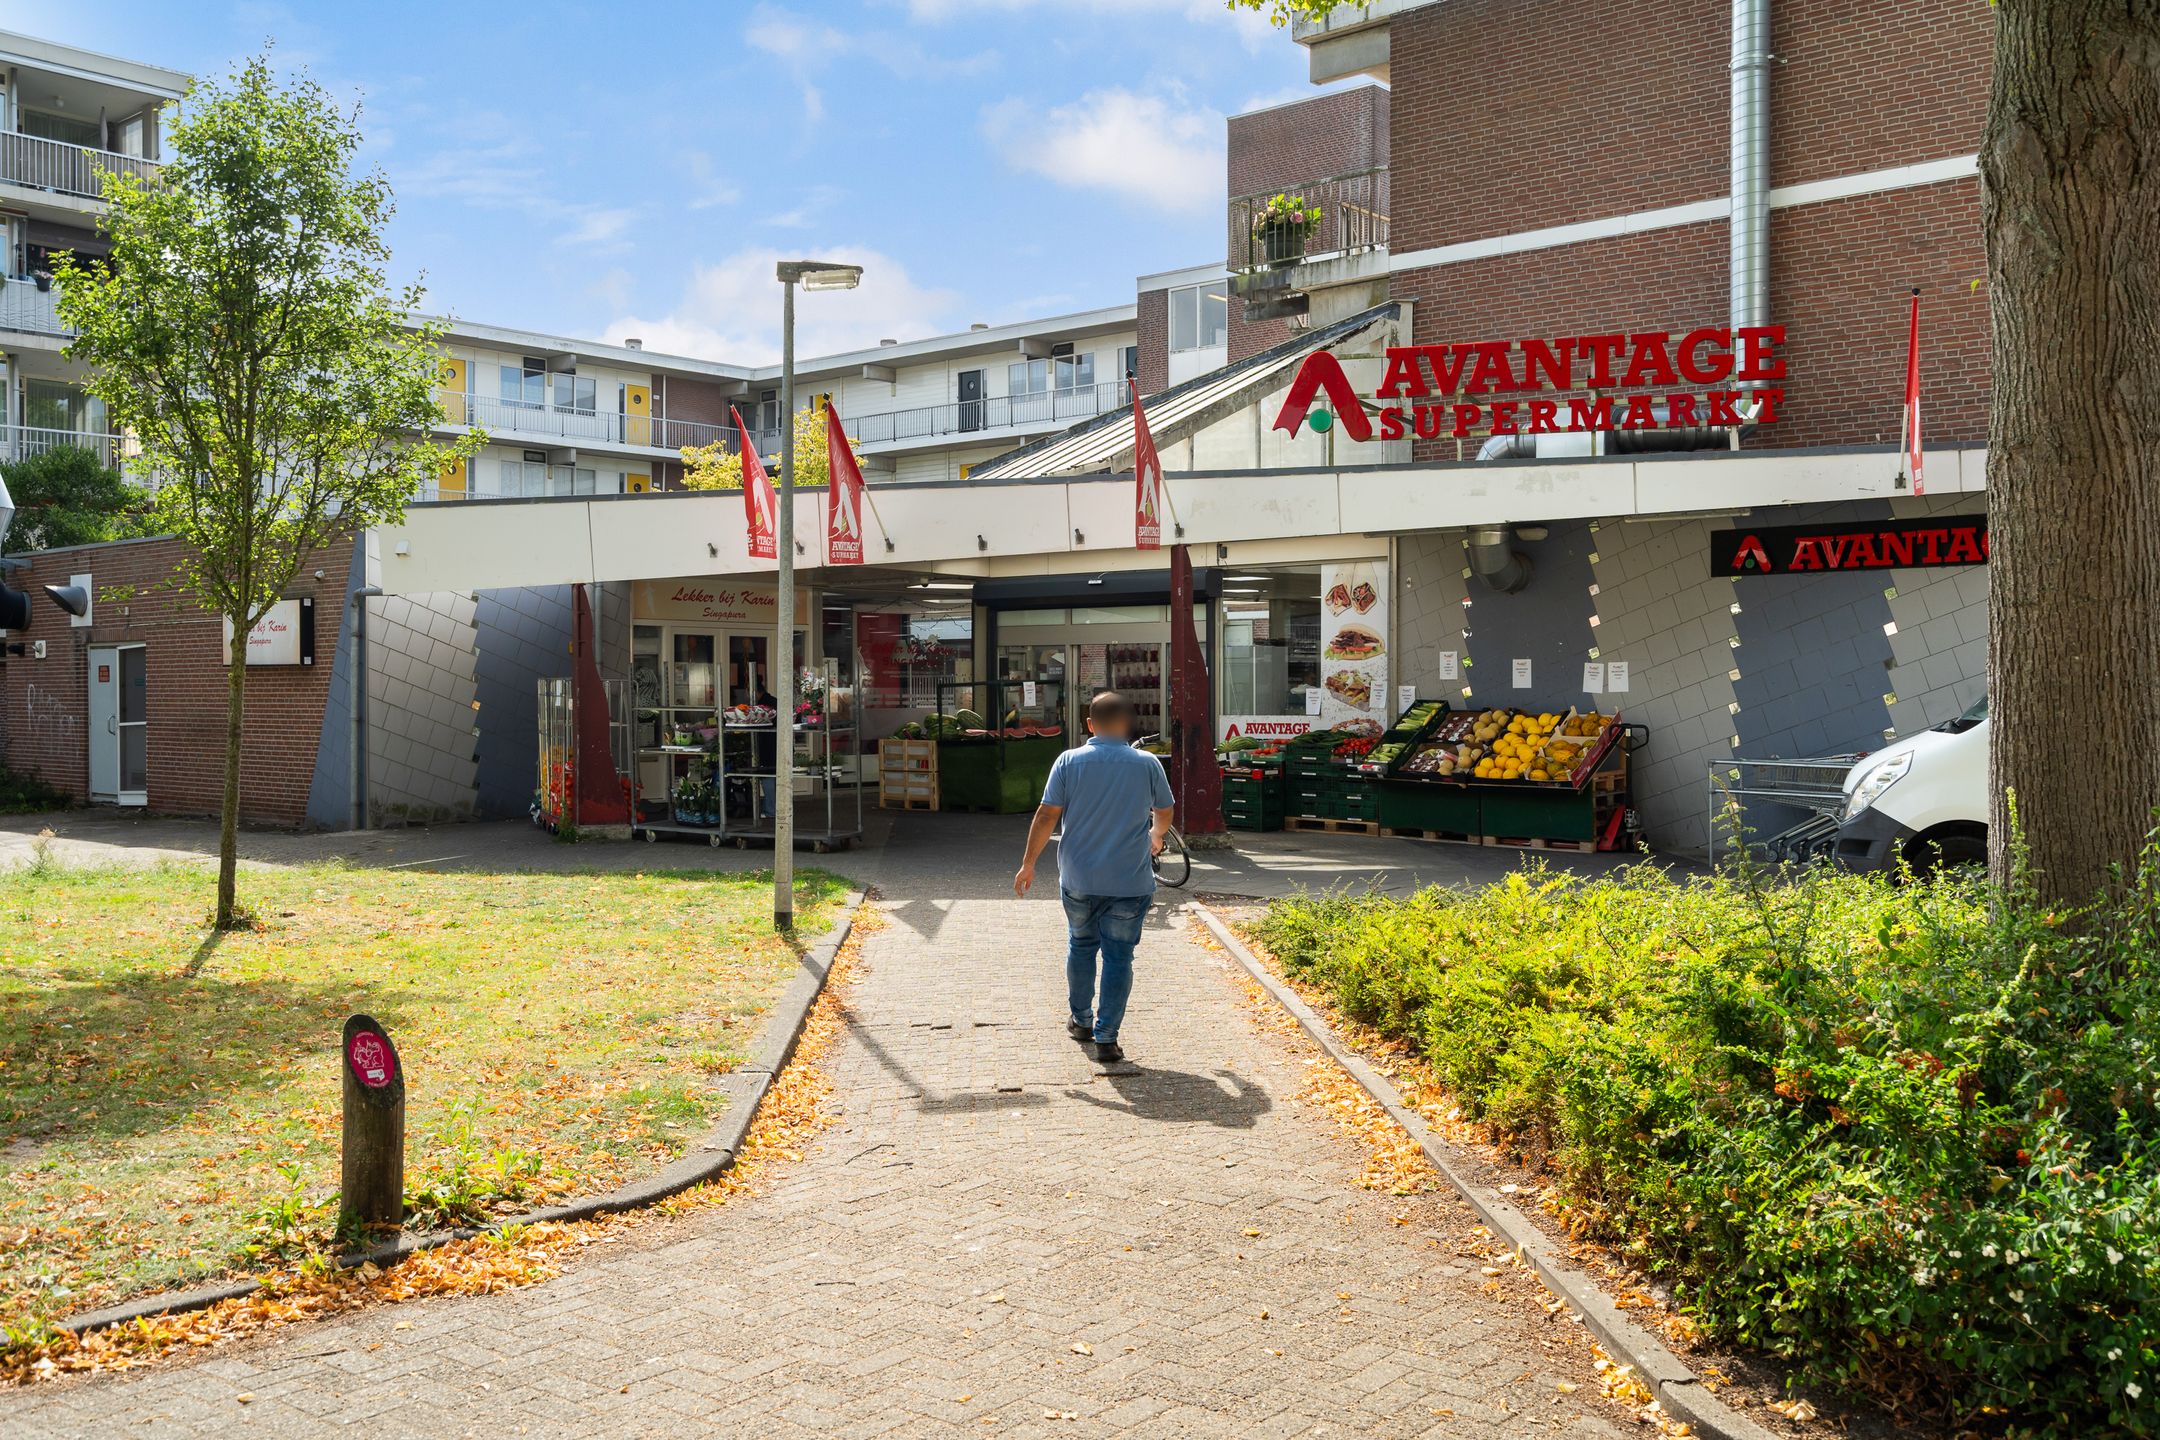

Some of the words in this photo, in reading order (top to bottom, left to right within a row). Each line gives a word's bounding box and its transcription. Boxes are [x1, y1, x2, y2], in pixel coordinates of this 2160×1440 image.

[1376, 325, 1786, 399] AVANTAGE
[1380, 389, 1784, 441] SUPERMARKT
[1788, 527, 1989, 571] AVANTA
[672, 587, 714, 603] Lekker
[719, 590, 735, 607] bij
[741, 590, 775, 606] Karin
[702, 607, 746, 620] Singapura
[269, 620, 287, 632] Karin
[1244, 722, 1310, 735] AVANTAGE
